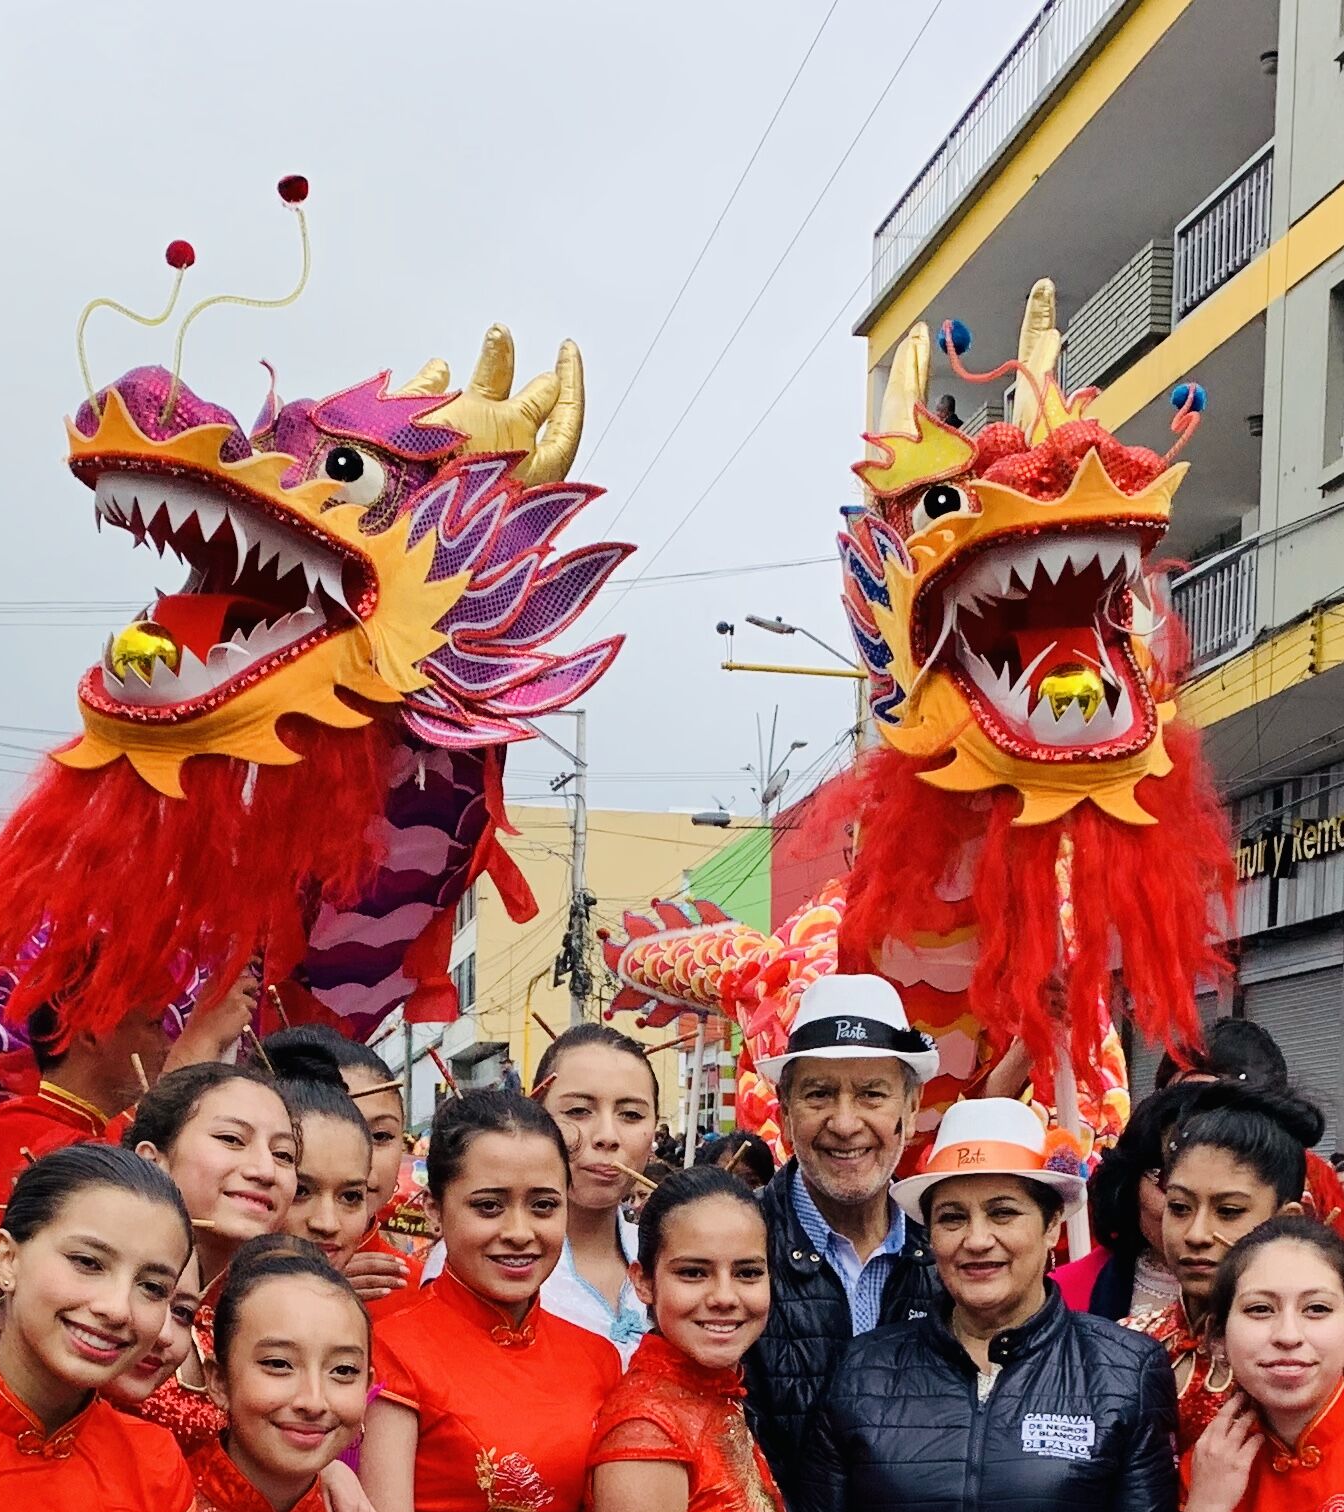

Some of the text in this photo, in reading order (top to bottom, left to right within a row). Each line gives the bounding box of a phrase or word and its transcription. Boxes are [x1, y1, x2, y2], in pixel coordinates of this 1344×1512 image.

[1272, 832, 1286, 878] y
[835, 1019, 868, 1041] Pasto
[957, 1147, 987, 1169] Pasto
[1024, 1412, 1093, 1425] CARNAVAL
[1039, 1431, 1088, 1442] BLANCOS
[1046, 1424, 1088, 1435] NEGROS
[1023, 1440, 1041, 1448] DE
[1044, 1440, 1089, 1455] PASTO
